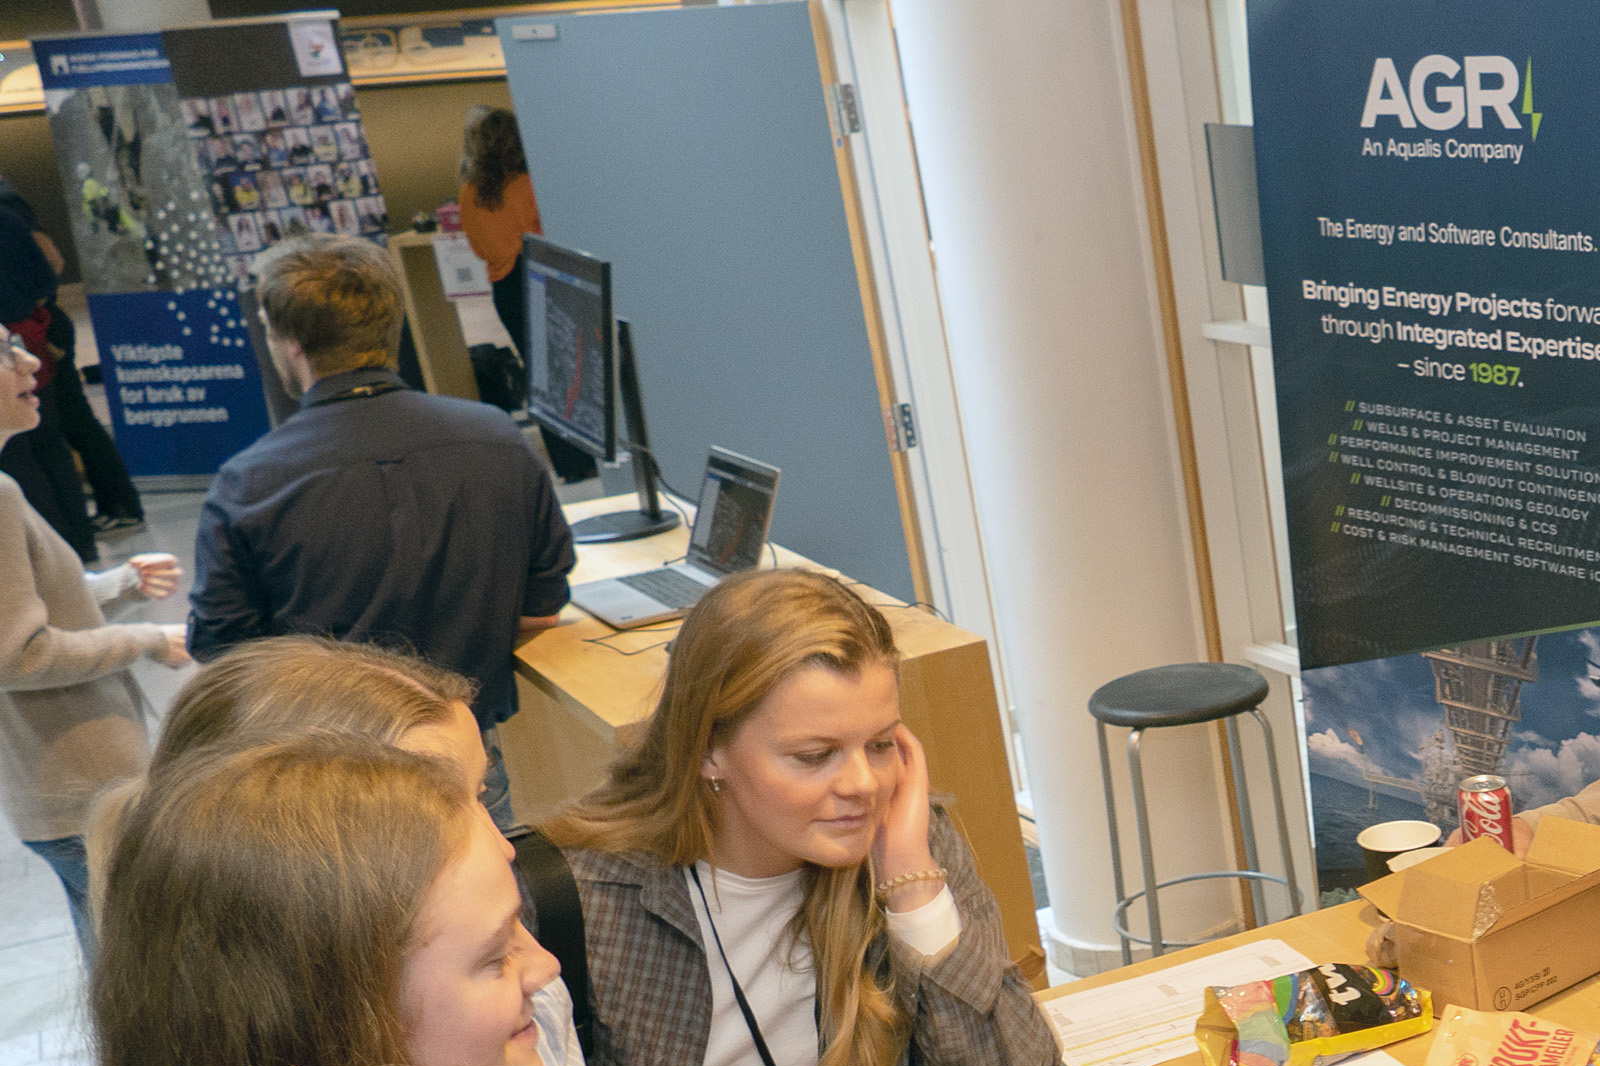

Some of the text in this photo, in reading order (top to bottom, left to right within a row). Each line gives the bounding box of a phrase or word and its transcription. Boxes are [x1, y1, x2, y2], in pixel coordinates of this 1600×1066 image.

[1360, 54, 1522, 131] AGR
[1362, 138, 1524, 164] An Aqualis Company
[1317, 216, 1599, 253] The Energy and Software Consultants.
[1302, 279, 1379, 310] Bringing
[1383, 286, 1452, 315] Energy
[1455, 292, 1543, 320] Projects
[1320, 314, 1394, 343] through
[1396, 320, 1502, 351] Integrated
[111, 343, 183, 364] Viktigste
[115, 364, 244, 384] kunnskapsarena
[1413, 357, 1466, 381] since
[1468, 362, 1524, 388] 1987.
[119, 386, 144, 404] for
[186, 387, 206, 402] av
[124, 407, 229, 427] berggrunnen
[1358, 401, 1442, 423] SUBSURFACE
[1457, 415, 1500, 430] ASSET
[1503, 421, 1587, 442] EVALUATION
[1340, 436, 1433, 459] PERFORMANCE
[1436, 447, 1532, 473] IMPROVEMENT
[1366, 421, 1408, 437] WELLS
[1423, 429, 1482, 448] PROJECT
[1485, 437, 1580, 461] MANAGEMENT
[1341, 453, 1375, 469] WELL
[1376, 459, 1435, 479] CONTROL
[1450, 470, 1514, 491] BLOWOUT
[1363, 474, 1425, 496] WELLSITE
[1439, 486, 1523, 511] OPERATIONS
[1526, 500, 1590, 522] GEOLOGY
[1394, 497, 1516, 529] DECOMMISSIONING
[1530, 520, 1558, 536] CCS
[1347, 507, 1427, 531] RESOURCING
[1441, 523, 1515, 548] TECHNICAL
[1342, 524, 1375, 539] COST
[1389, 531, 1418, 547] RISK
[1420, 536, 1511, 564] MANAGEMENT
[1513, 554, 1586, 580] SOFTWARE
